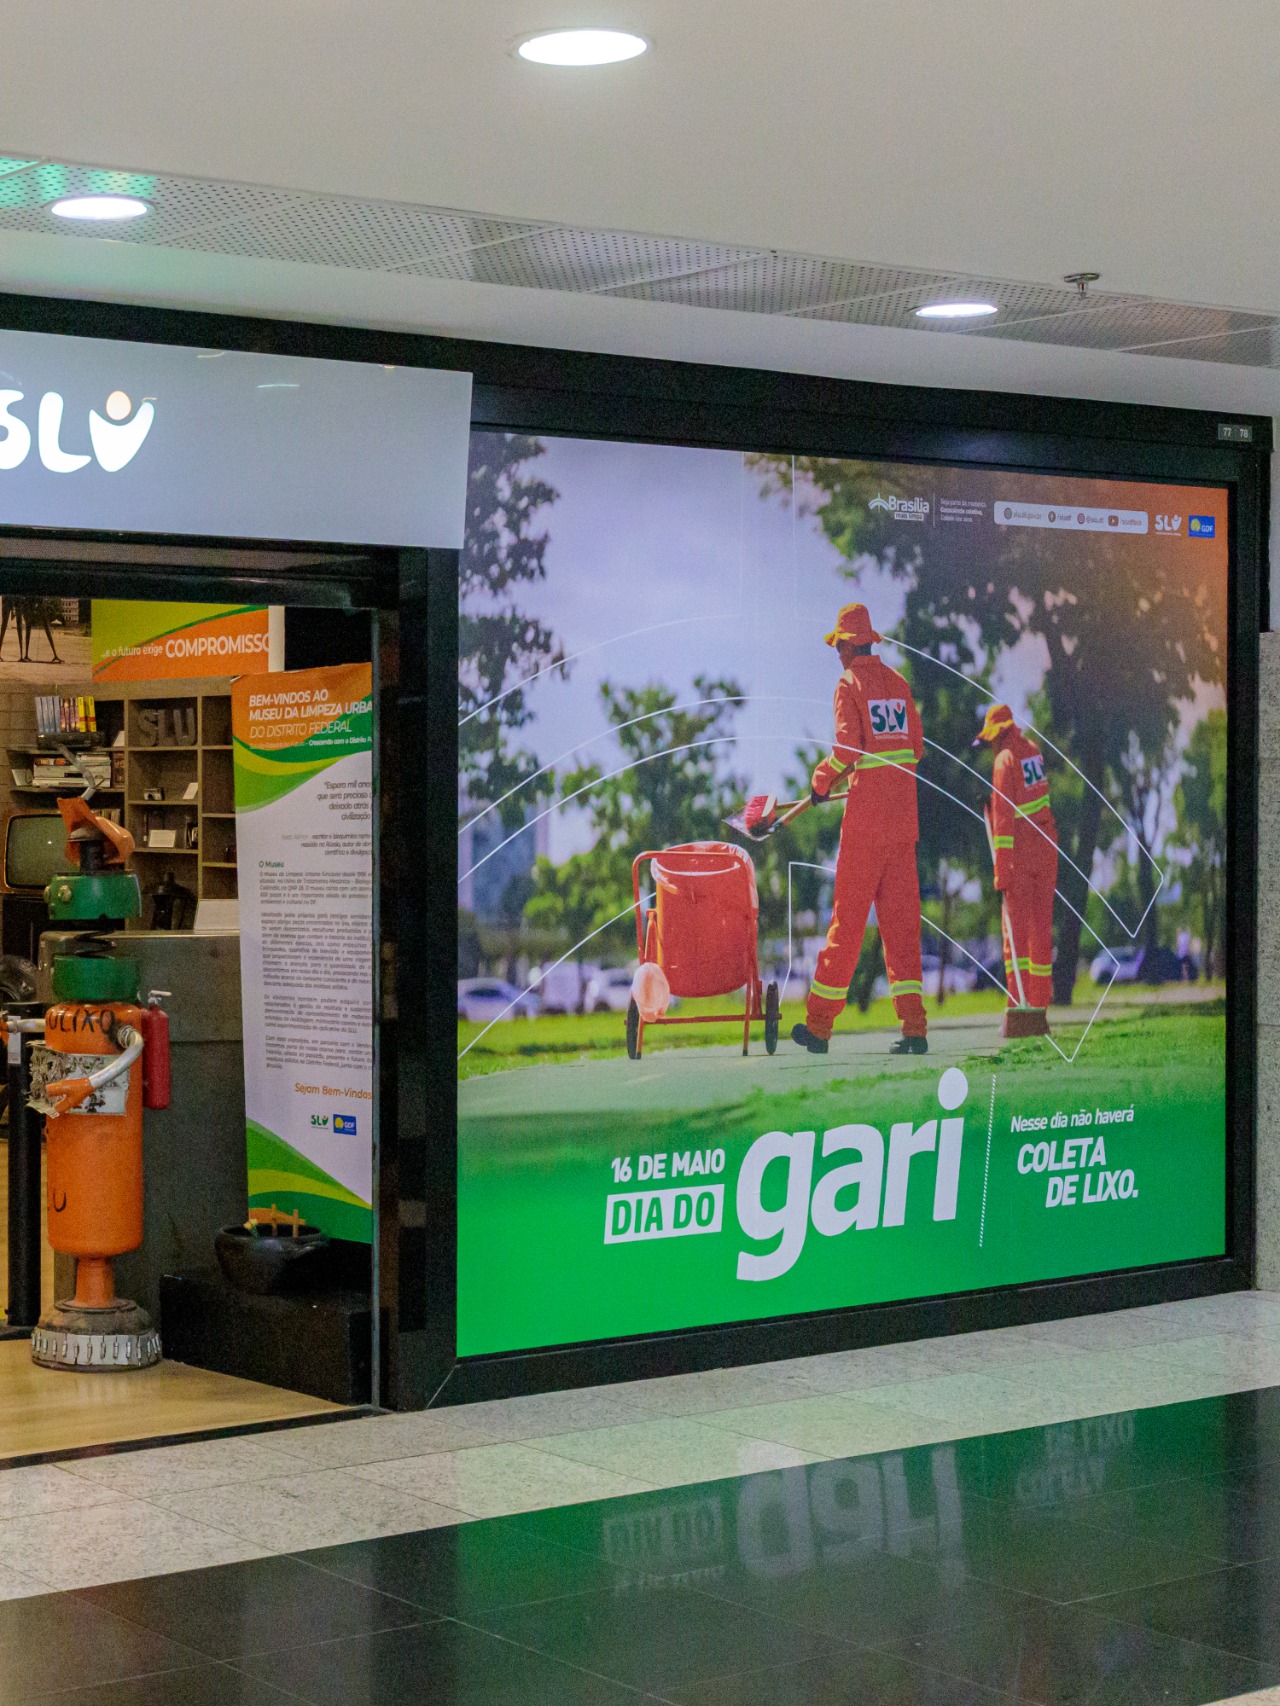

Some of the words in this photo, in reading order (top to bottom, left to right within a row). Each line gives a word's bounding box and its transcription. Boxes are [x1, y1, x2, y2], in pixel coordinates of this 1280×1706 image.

[888, 495, 930, 513] Brasília
[118, 645, 141, 657] futuro
[142, 644, 163, 658] exige
[249, 690, 310, 707] BEM-VINDOS
[312, 689, 328, 702] AO
[249, 708, 282, 721] MUSEU
[284, 706, 298, 719] DA
[300, 703, 342, 718] LIMPEZA
[138, 708, 196, 746] SLU
[250, 726, 265, 738] DO
[266, 722, 307, 738] DISTRITO
[308, 720, 352, 734] FEDERAL
[317, 793, 328, 801] que
[343, 792, 368, 801] precioso
[329, 802, 353, 810] deixado
[265, 860, 284, 868] Museu
[294, 1082, 320, 1095] Sejam
[322, 1085, 372, 1100] Bem-Vindos
[1011, 1114, 1048, 1134] Nesse
[1050, 1112, 1068, 1130] dia
[1071, 1108, 1093, 1128] não
[1095, 1102, 1134, 1126] haverá
[1017, 1136, 1107, 1176] COLETA
[611, 1156, 632, 1184] 16
[638, 1154, 666, 1181] DE
[672, 1148, 726, 1178] MAIO
[736, 1066, 968, 1282] gari
[1045, 1176, 1078, 1209] DE
[1080, 1170, 1140, 1203] LIXO.
[612, 1196, 662, 1237] DIA
[673, 1190, 716, 1230] DO
